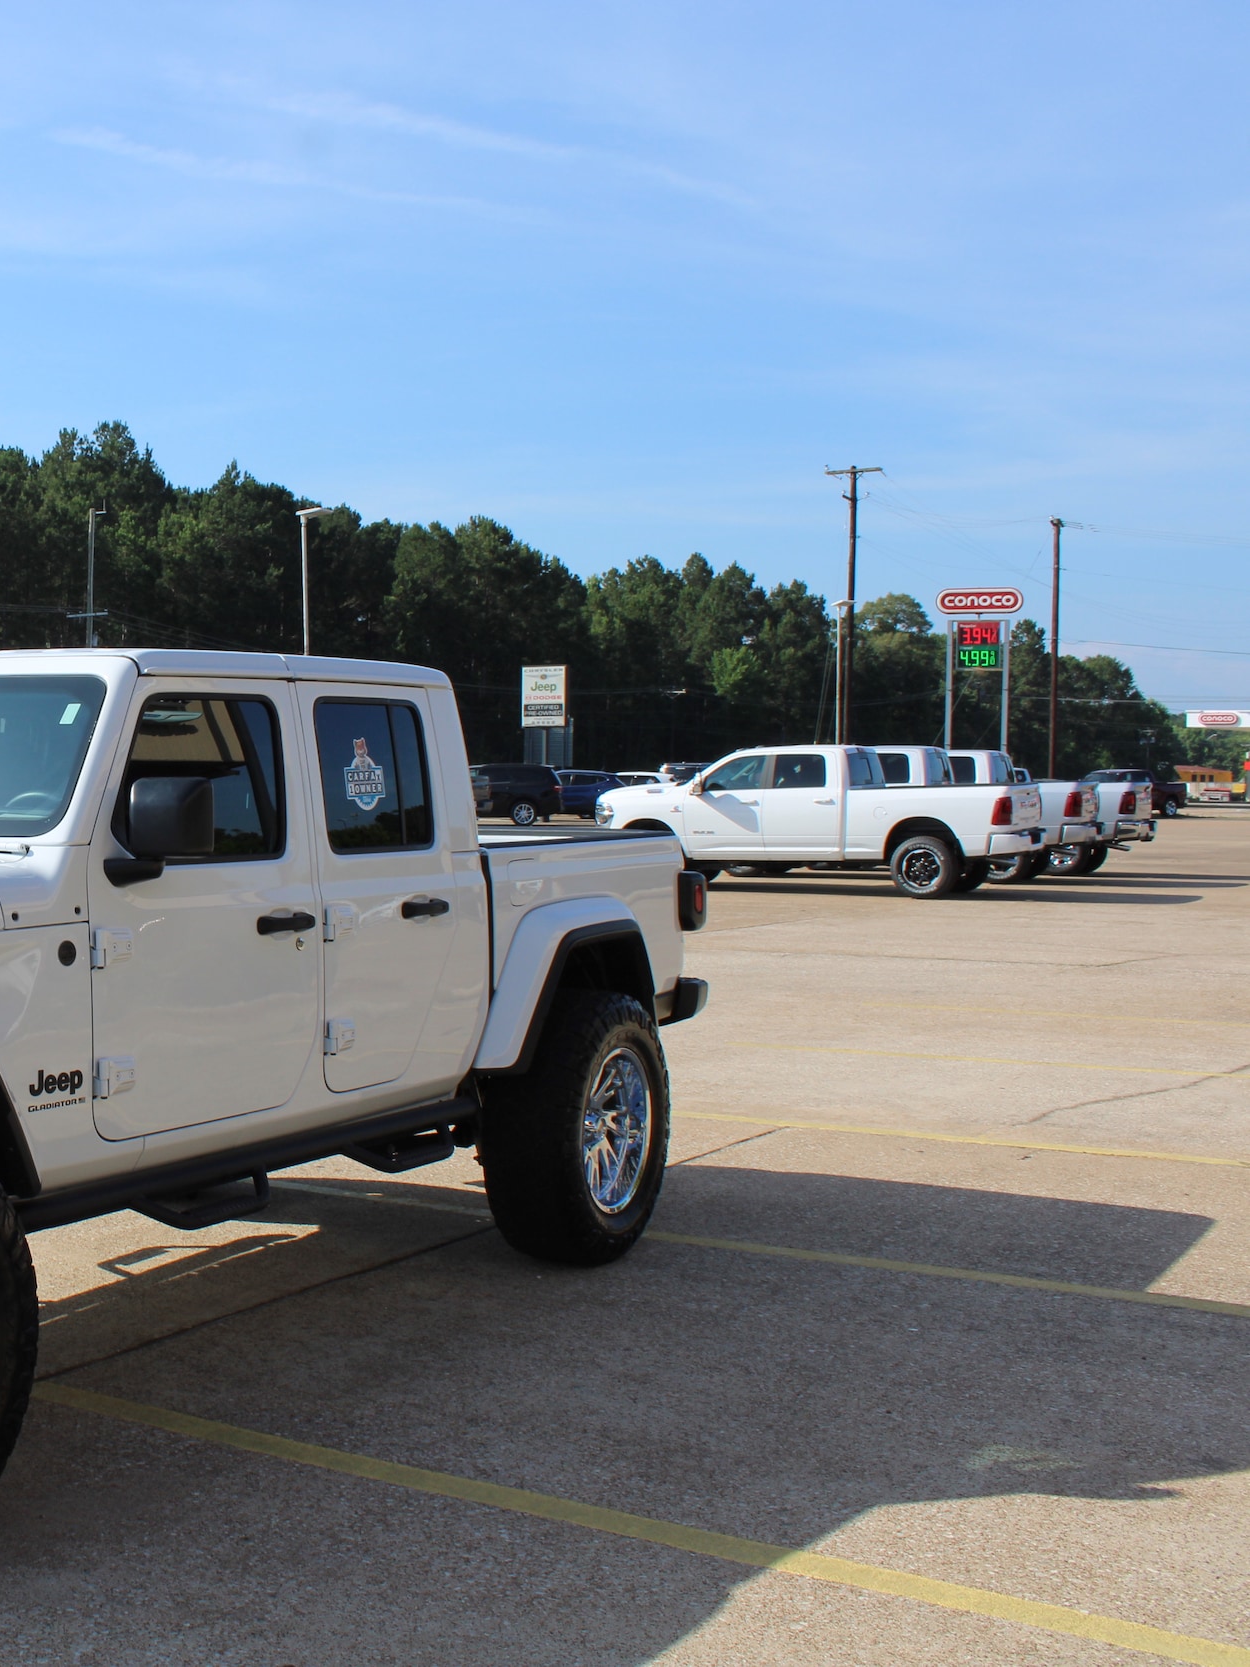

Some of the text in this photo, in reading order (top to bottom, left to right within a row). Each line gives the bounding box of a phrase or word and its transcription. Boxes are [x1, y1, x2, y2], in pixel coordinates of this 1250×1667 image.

[962, 628, 991, 645] 3.94
[960, 650, 989, 667] 4.99
[530, 681, 557, 693] Jeep
[347, 770, 382, 782] CARFAX
[29, 1069, 83, 1097] Jeep
[27, 1098, 77, 1113] GLADIATOR
